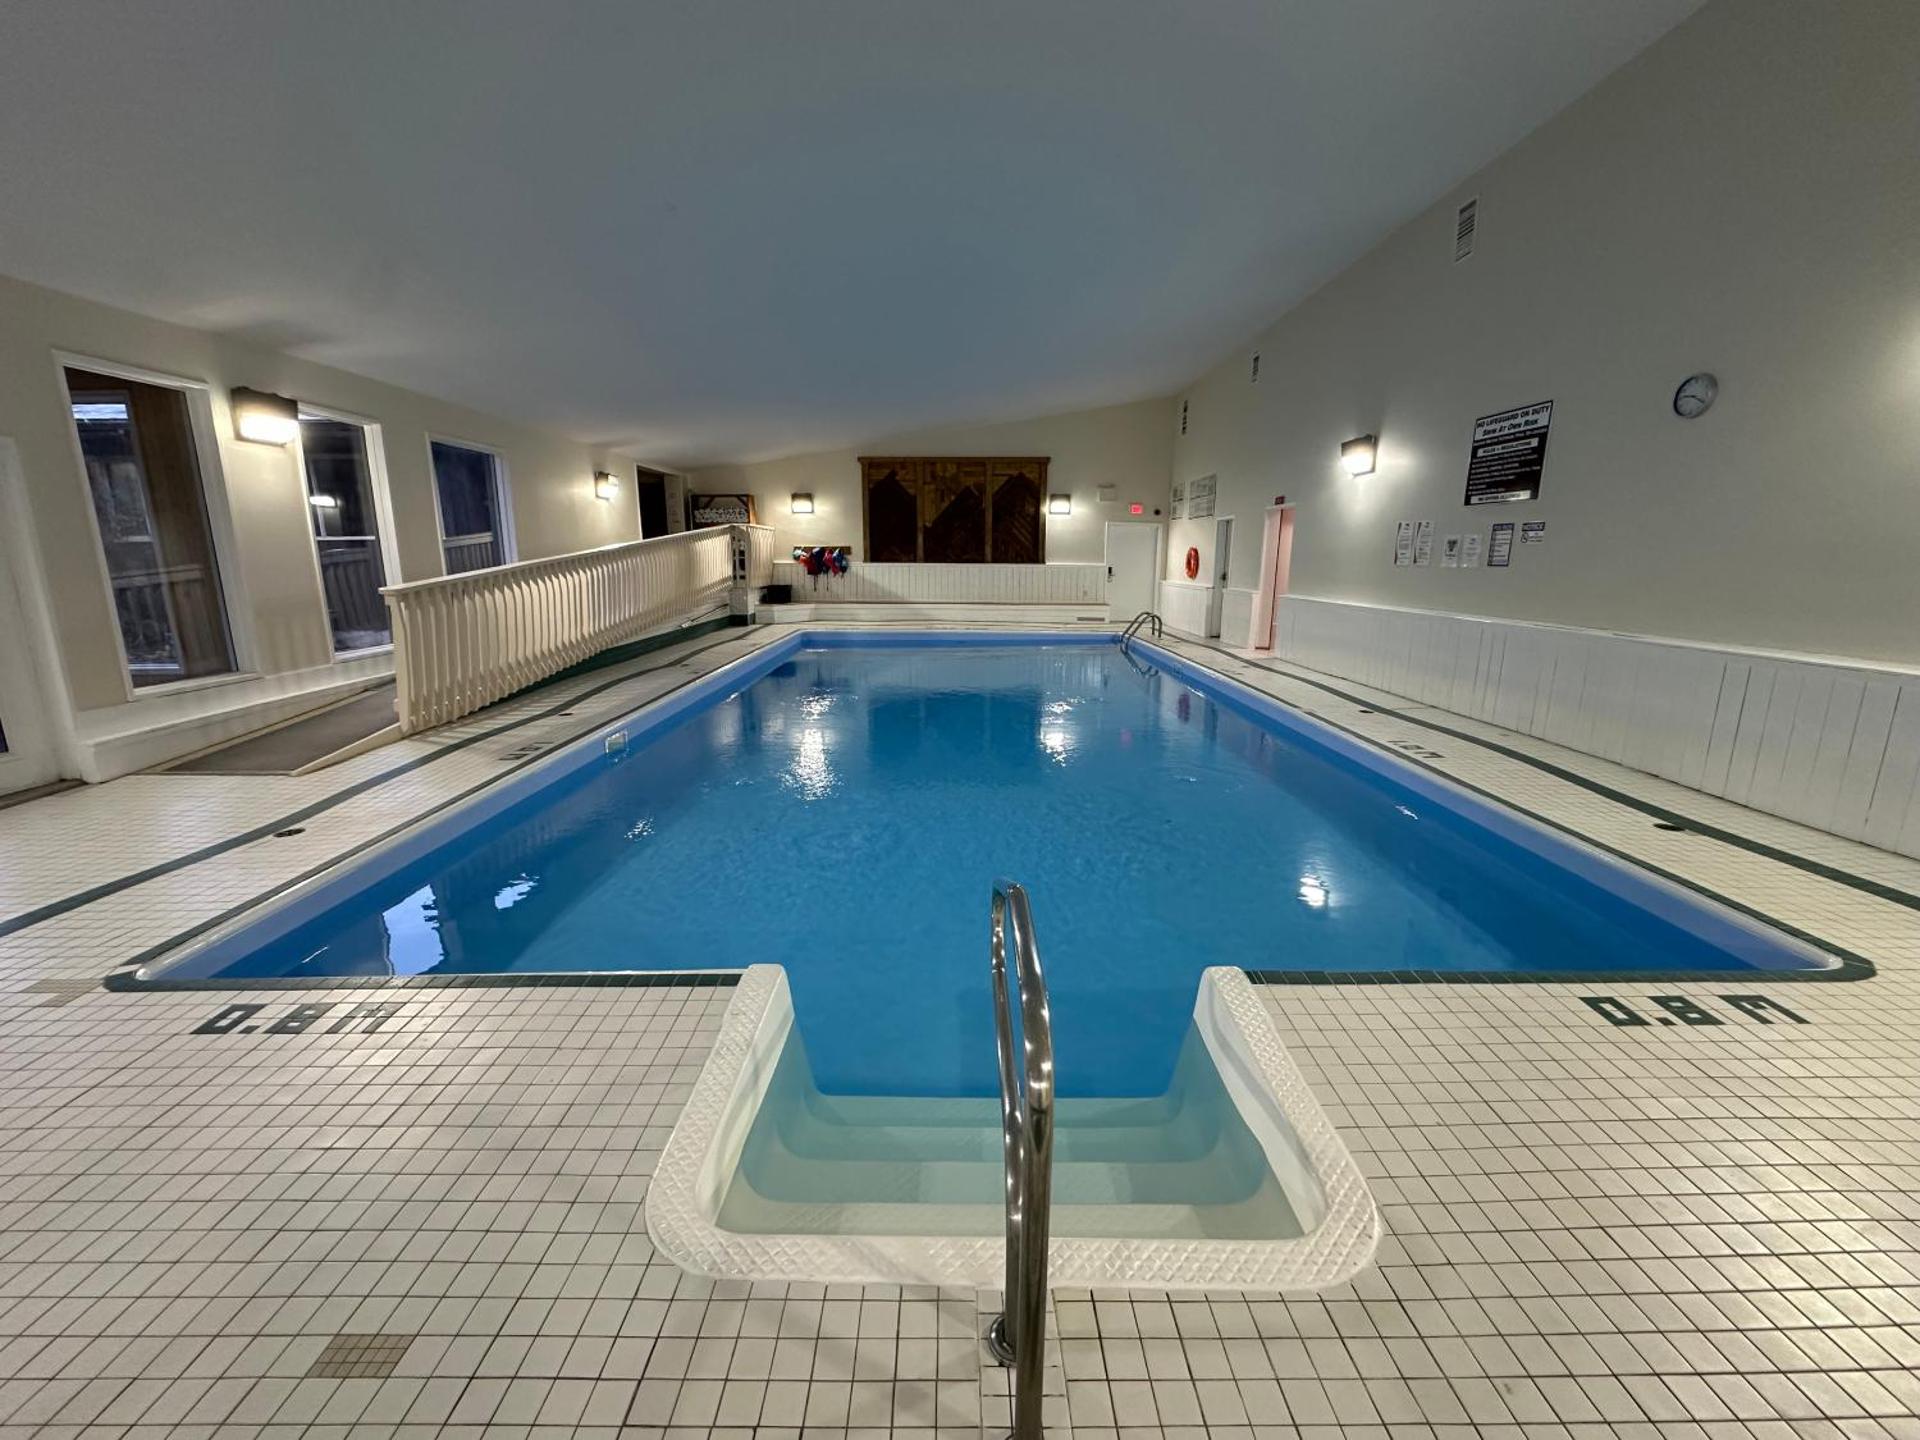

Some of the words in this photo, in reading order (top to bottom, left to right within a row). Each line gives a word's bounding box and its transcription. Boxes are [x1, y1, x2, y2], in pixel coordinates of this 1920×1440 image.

[1486, 414, 1519, 425] LIFEGUARD
[1520, 410, 1530, 418] ON
[1531, 406, 1550, 415] DUTY
